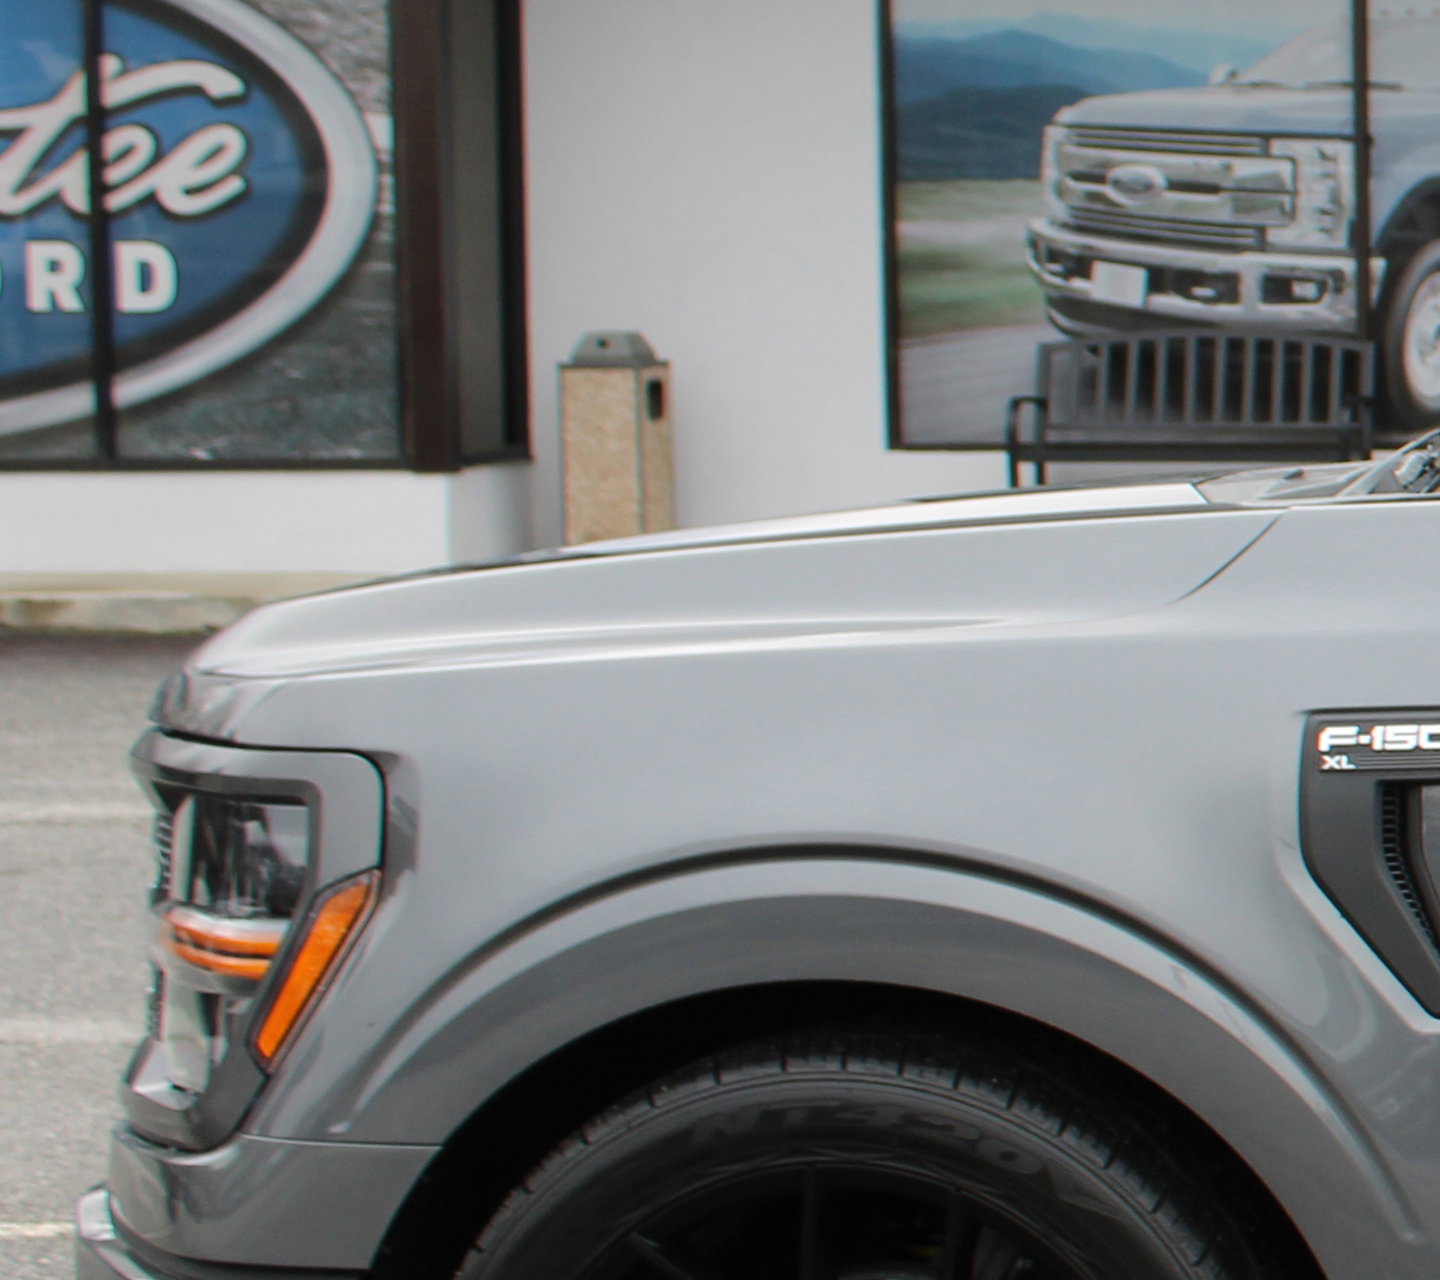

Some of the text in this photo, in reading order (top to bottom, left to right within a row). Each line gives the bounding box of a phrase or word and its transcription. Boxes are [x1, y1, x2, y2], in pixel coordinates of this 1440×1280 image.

[0, 52, 248, 217] tee
[0, 238, 180, 313] RD
[1319, 754, 1357, 770] XL
